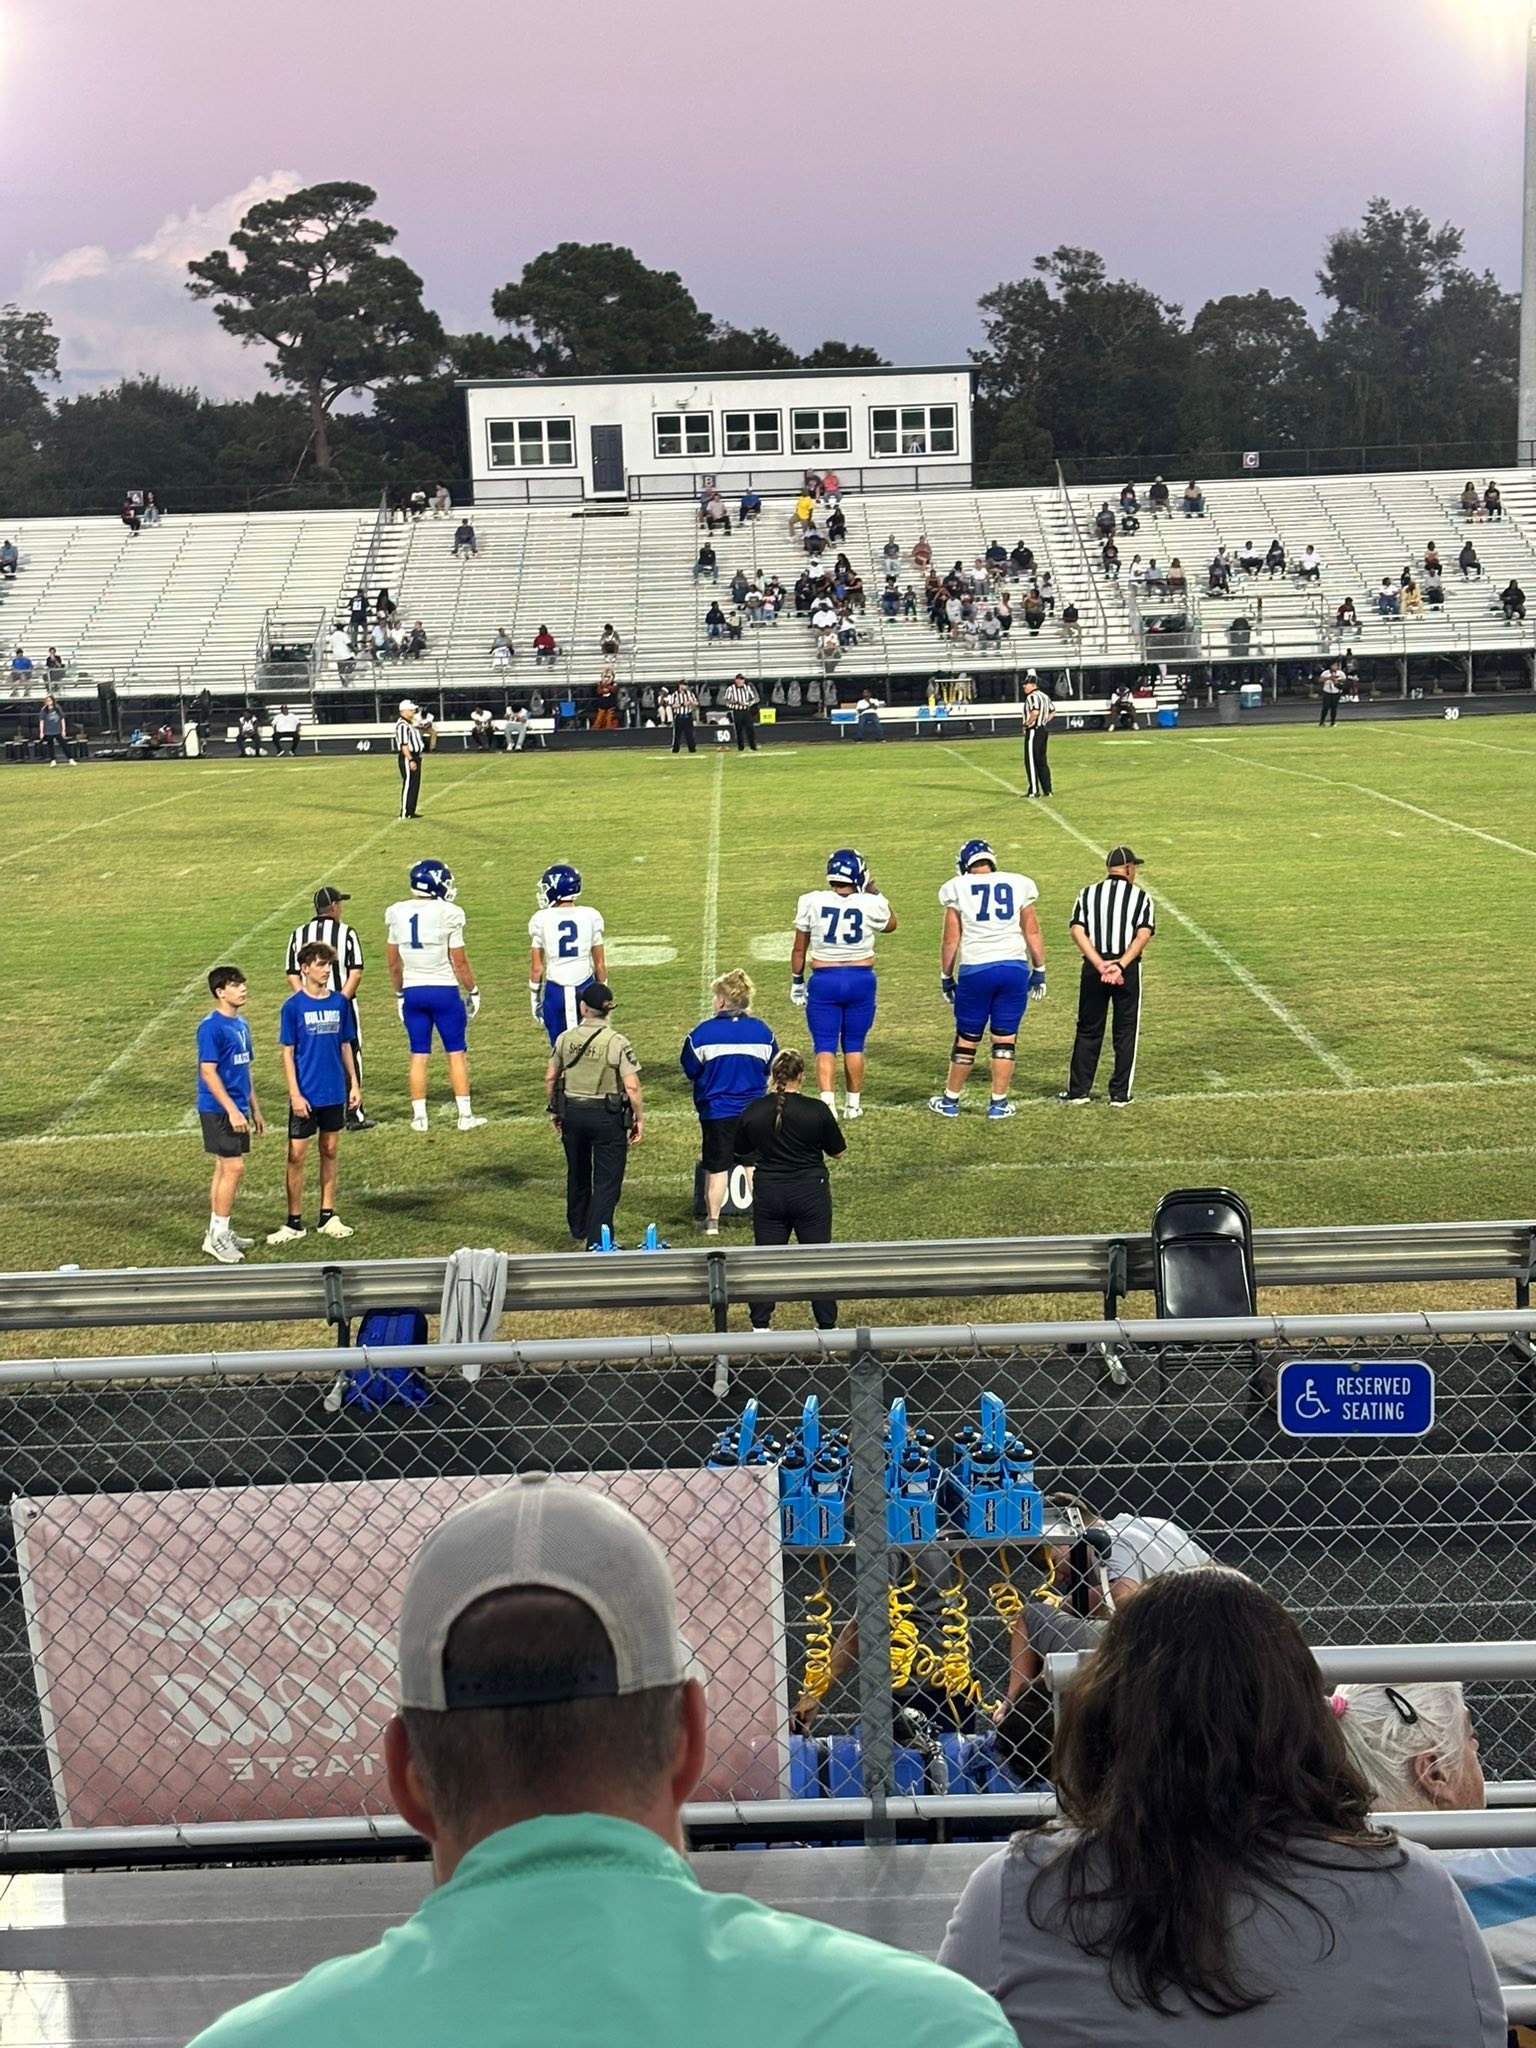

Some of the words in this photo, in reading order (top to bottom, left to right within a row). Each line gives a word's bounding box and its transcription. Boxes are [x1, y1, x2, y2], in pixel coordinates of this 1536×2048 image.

[1246, 454, 1256, 466] C
[704, 476, 714, 487] B
[1444, 707, 1460, 720] 30
[1070, 716, 1085, 728] 40
[716, 730, 731, 742] 50
[356, 740, 371, 751] 40
[970, 882, 1014, 922] 79
[408, 913, 425, 949] 1
[820, 906, 863, 944] 73
[557, 920, 579, 958] 2
[568, 1042, 597, 1058] SHEFF
[1336, 1377, 1412, 1396] RESERVED
[1342, 1402, 1405, 1421] SEATING
